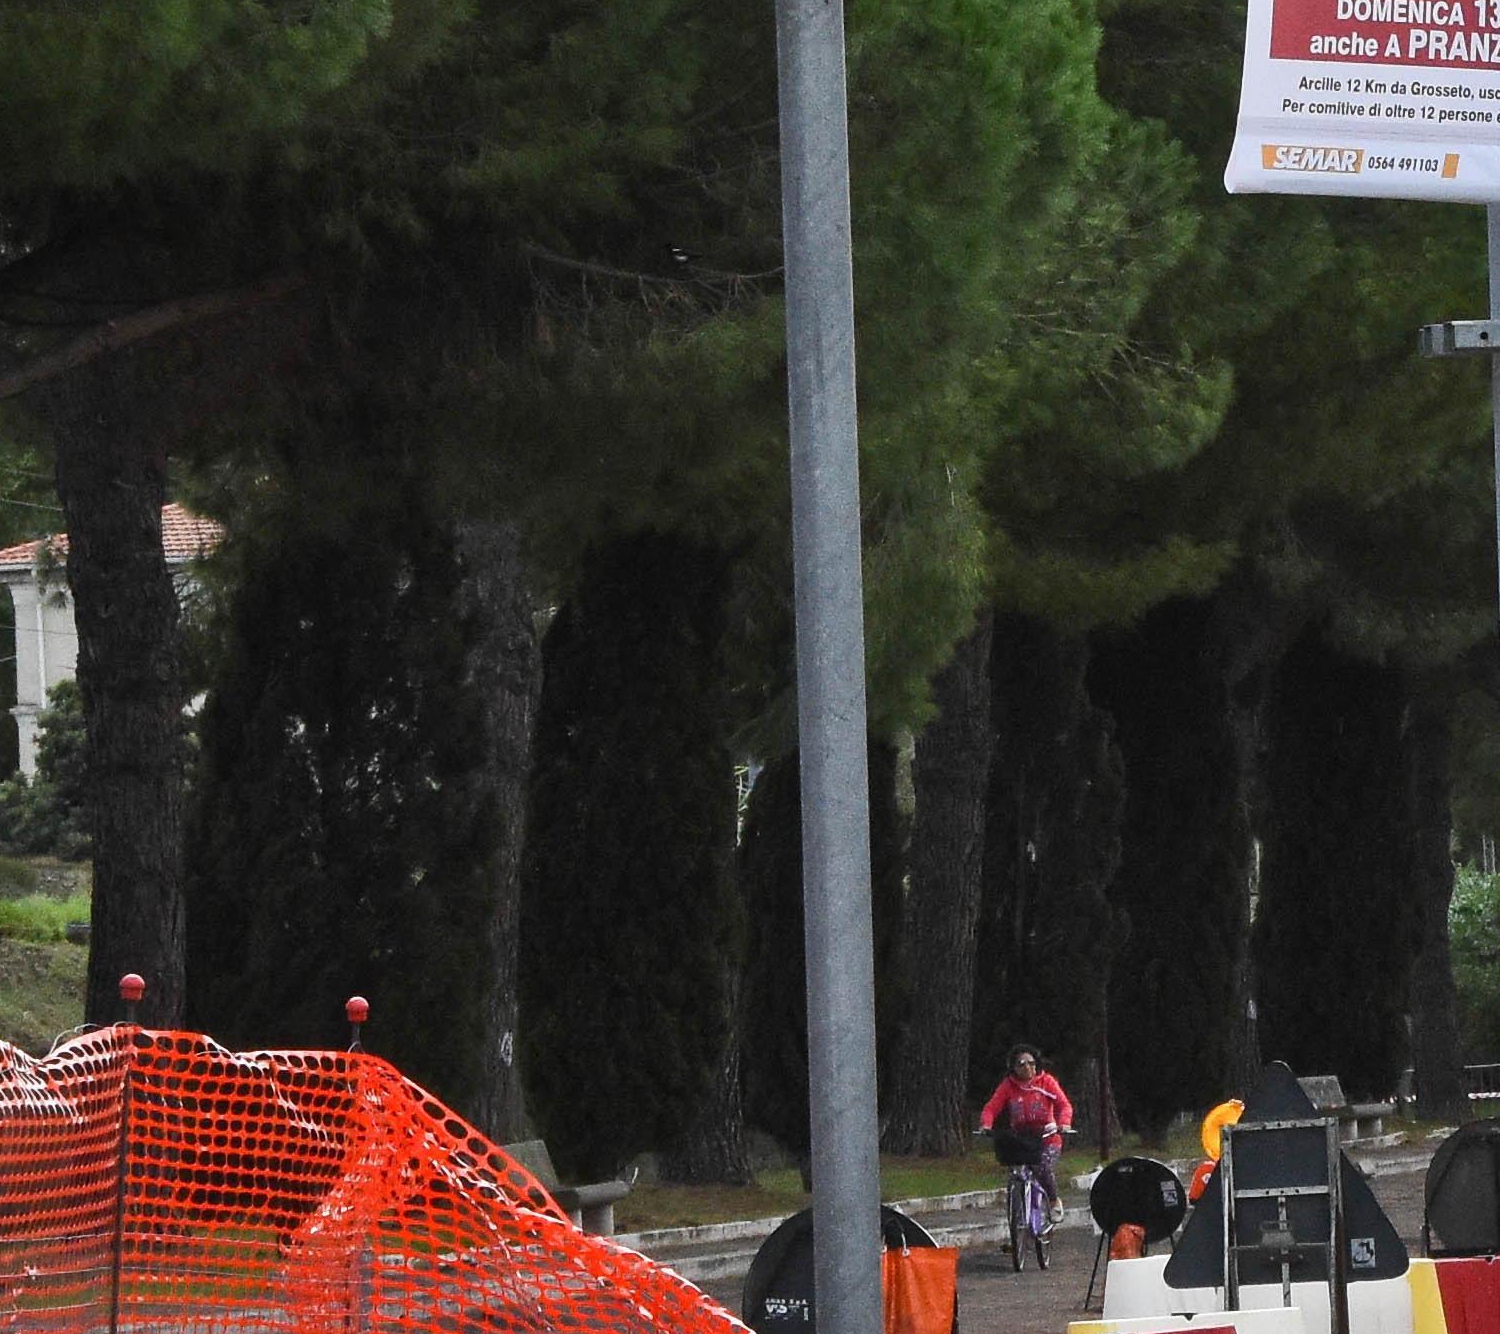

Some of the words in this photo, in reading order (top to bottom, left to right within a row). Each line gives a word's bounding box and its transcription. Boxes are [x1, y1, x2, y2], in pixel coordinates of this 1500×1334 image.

[1310, 32, 1378, 56] anche
[1384, 35, 1400, 57] A
[1298, 76, 1342, 92] Arcille
[1346, 79, 1361, 93] 12
[1365, 79, 1387, 94] Km
[1390, 81, 1407, 95] da
[1410, 82, 1475, 100] Grosseto,
[1282, 98, 1304, 114] Per
[1308, 101, 1365, 116] comitive
[1368, 103, 1381, 117] di
[1385, 104, 1415, 118] oltre
[1420, 106, 1435, 119] 12
[1438, 109, 1492, 124] persone
[1273, 147, 1358, 172] SEMAR
[1368, 156, 1395, 170] 0564
[1398, 157, 1439, 172] 491103
